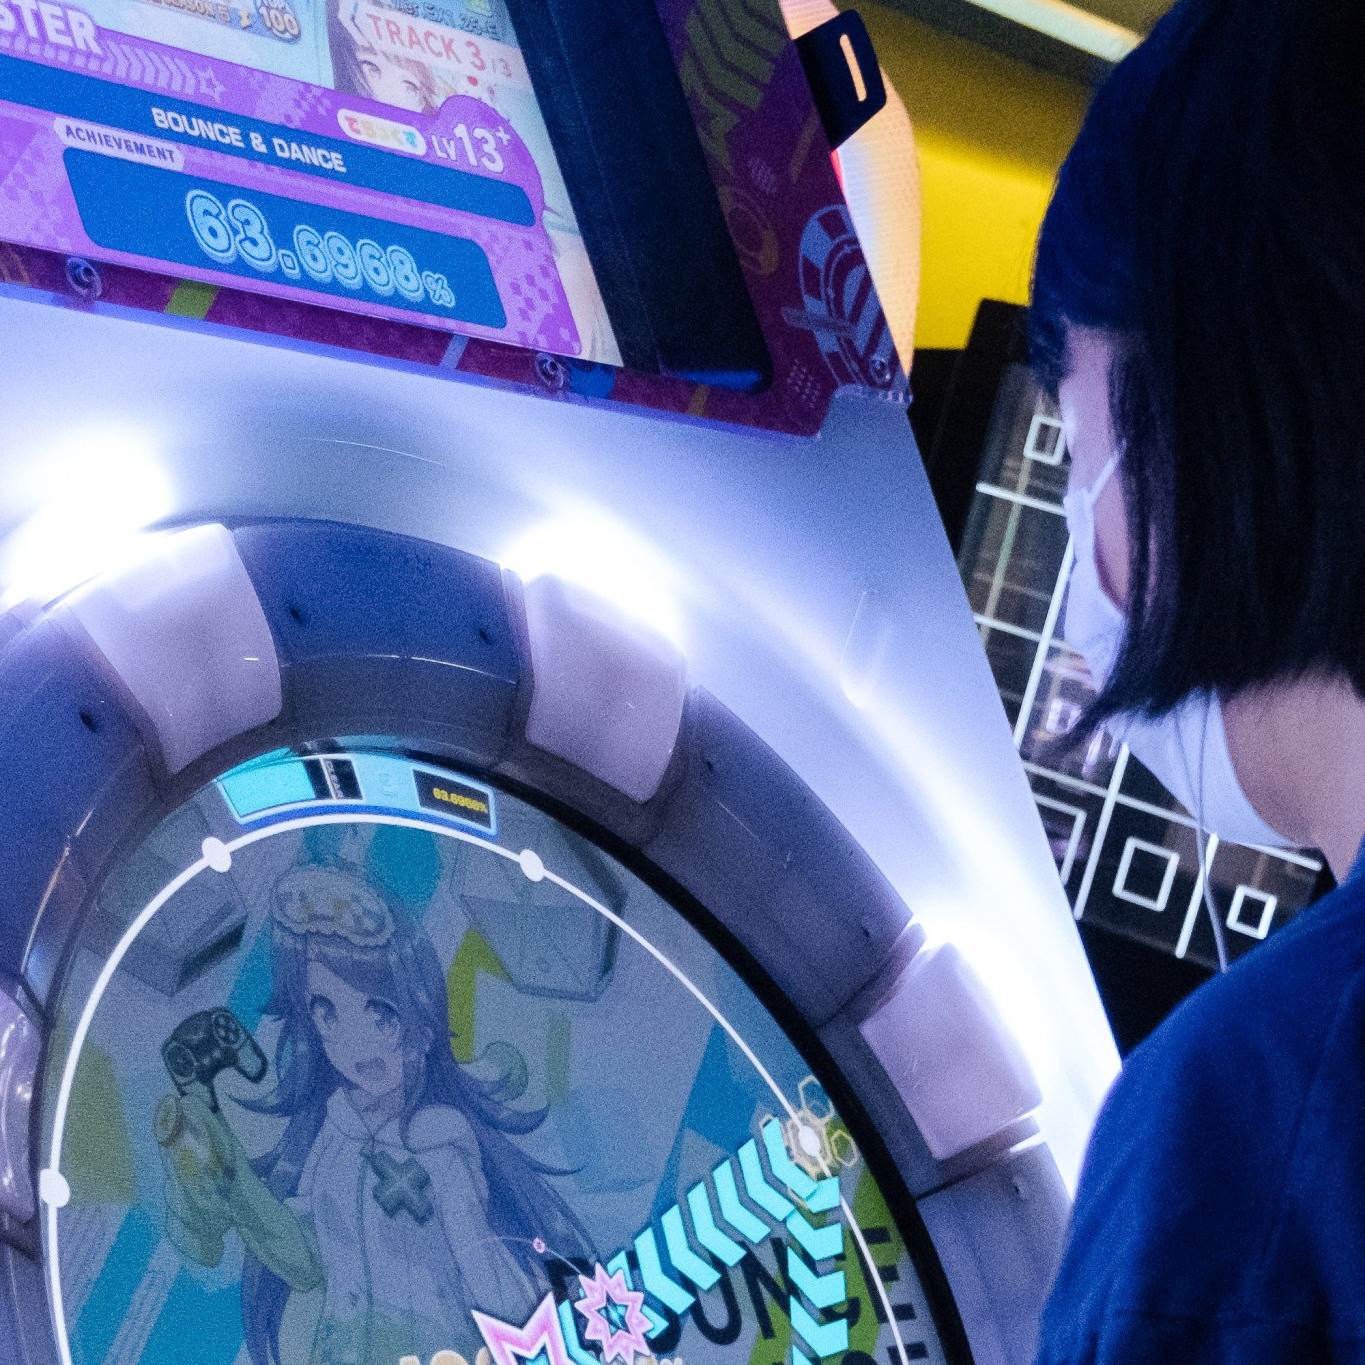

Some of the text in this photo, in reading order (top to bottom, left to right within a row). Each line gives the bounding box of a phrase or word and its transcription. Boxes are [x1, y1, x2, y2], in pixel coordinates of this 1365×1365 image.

[260, 6, 301, 37] 100
[367, 13, 461, 64] TRACK
[64, 123, 176, 165] ACHIEVEMENT
[151, 107, 347, 173] BOUNCE & DANCE
